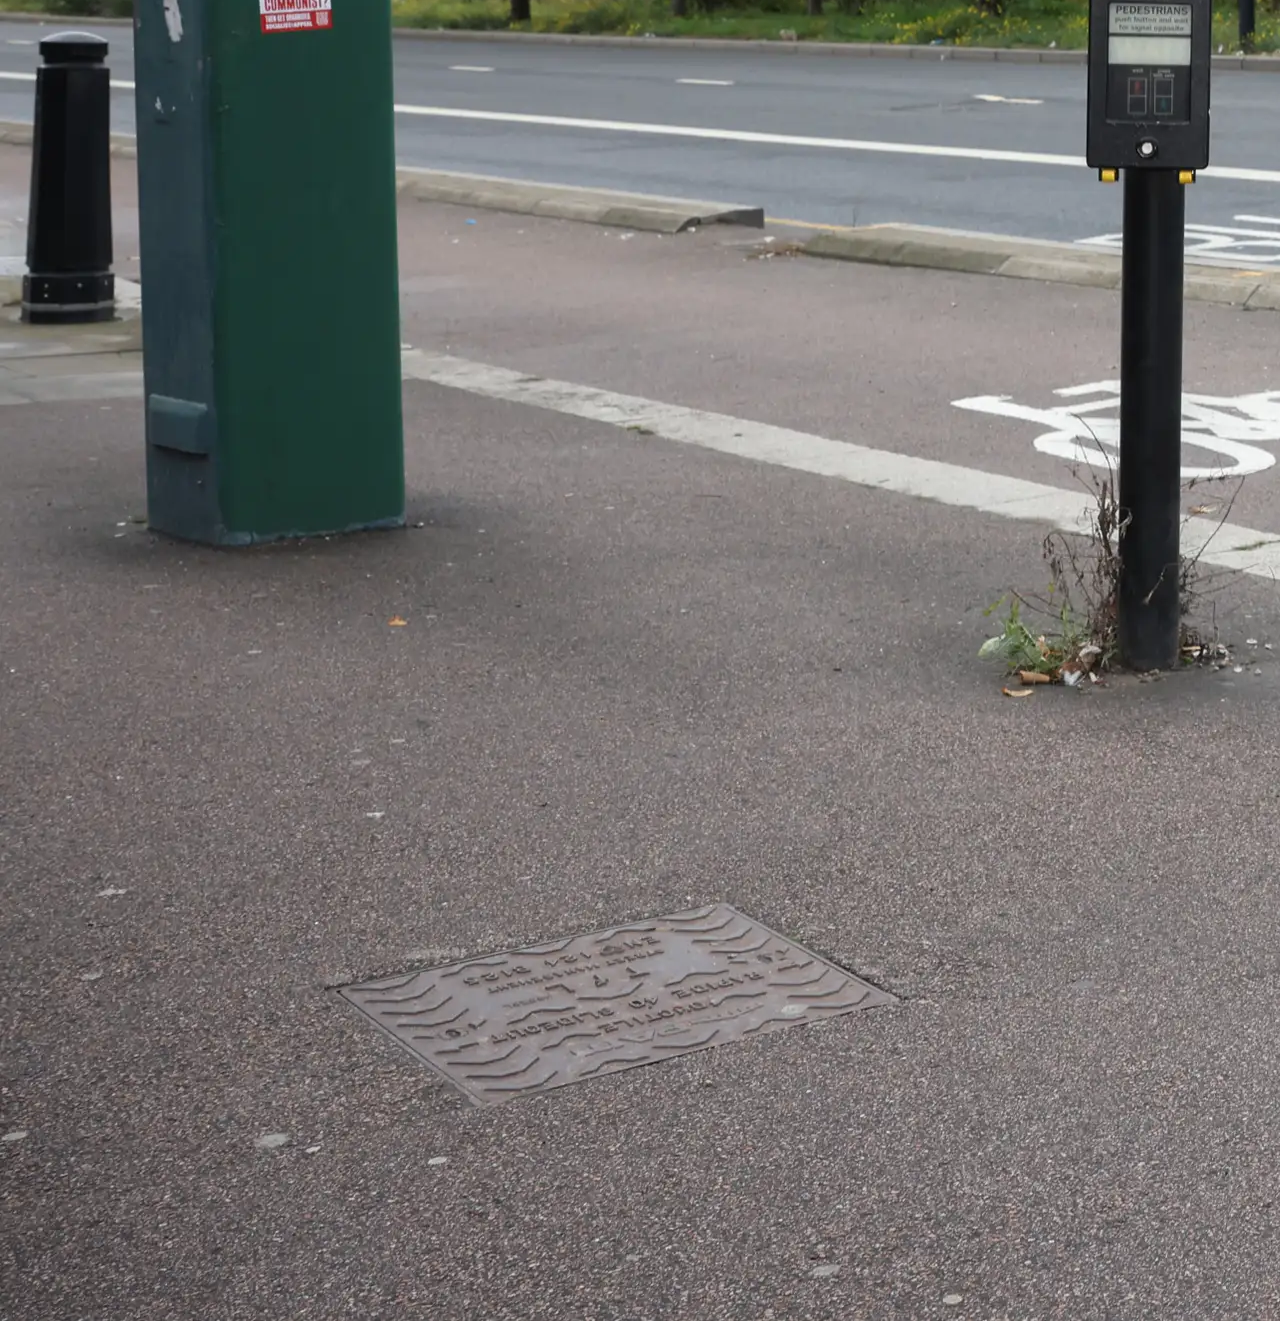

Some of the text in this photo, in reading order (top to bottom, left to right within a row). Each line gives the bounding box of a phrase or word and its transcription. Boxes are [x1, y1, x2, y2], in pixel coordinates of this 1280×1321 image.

[1116, 5, 1189, 15] PEDESTRIANS
[1114, 16, 1132, 24] push
[1130, 24, 1152, 32] signal
[1153, 24, 1184, 33] opposite
